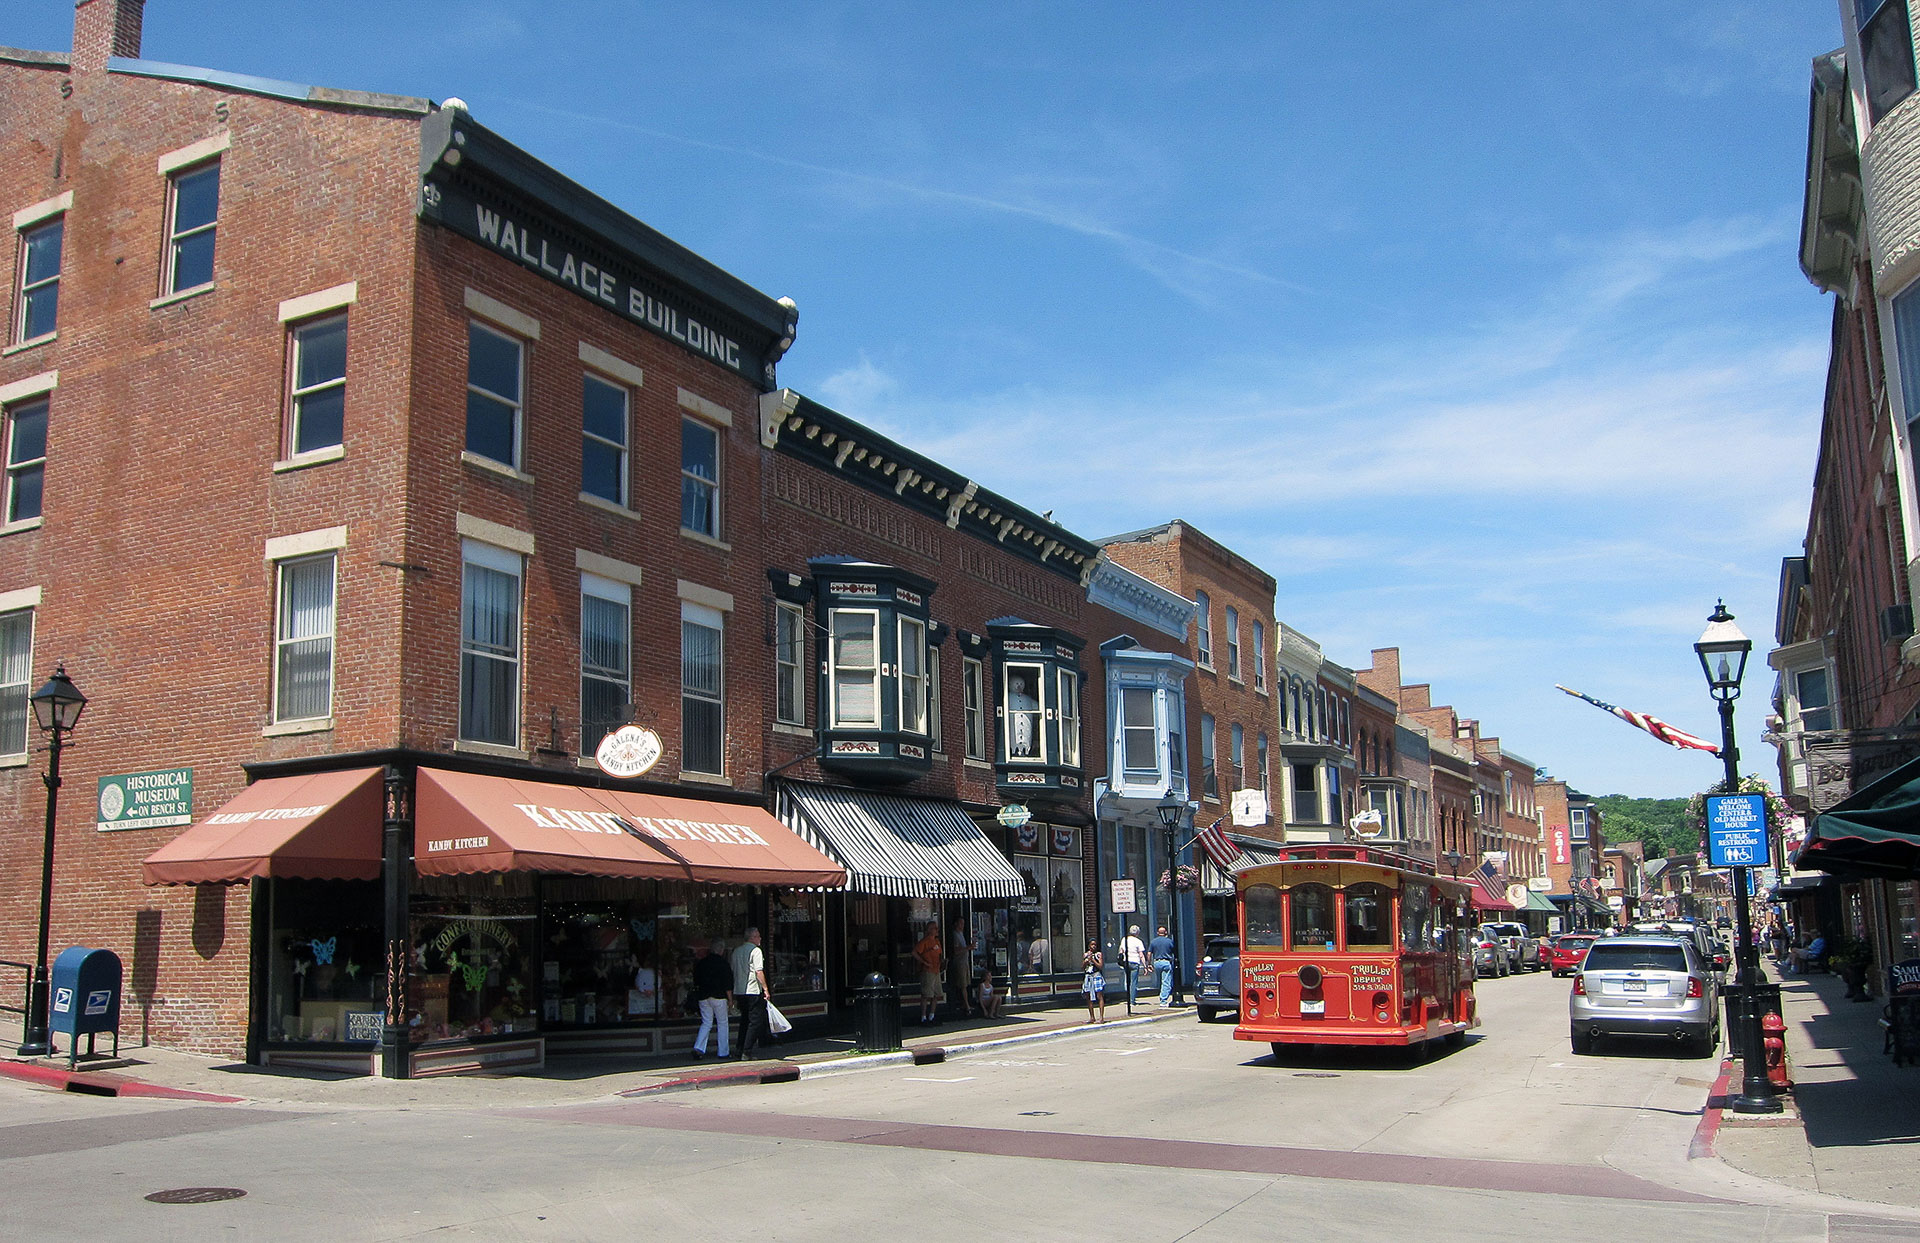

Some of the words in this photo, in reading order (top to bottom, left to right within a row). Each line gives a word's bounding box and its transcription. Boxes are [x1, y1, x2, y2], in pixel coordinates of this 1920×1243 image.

[476, 203, 616, 304] WALLACE
[629, 286, 740, 369] BUILDING
[600, 752, 624, 771] KANDY
[626, 748, 657, 771] KITCHEN
[126, 771, 190, 790] HISTORICAL
[134, 787, 180, 804] MUSEUM
[138, 805, 150, 816] ON
[151, 802, 176, 816] BENCH
[177, 801, 189, 813] ST.
[113, 821, 126, 829] TURN
[127, 820, 139, 828] LEFT
[513, 803, 625, 836] KANDY
[631, 815, 771, 847] KITCHEN
[1724, 821, 1749, 829] HOUSE
[1717, 838, 1758, 847] RESTROOMS
[1724, 832, 1750, 840] PUBLIC
[427, 840, 454, 852] KANDY
[454, 836, 489, 850] KITCHEN
[925, 883, 939, 894] ICE
[940, 883, 967, 894] CREAM
[435, 919, 514, 952] CONFECTIONERY
[1244, 963, 1275, 978] TROLLEY
[1350, 964, 1391, 977] TROLLEY
